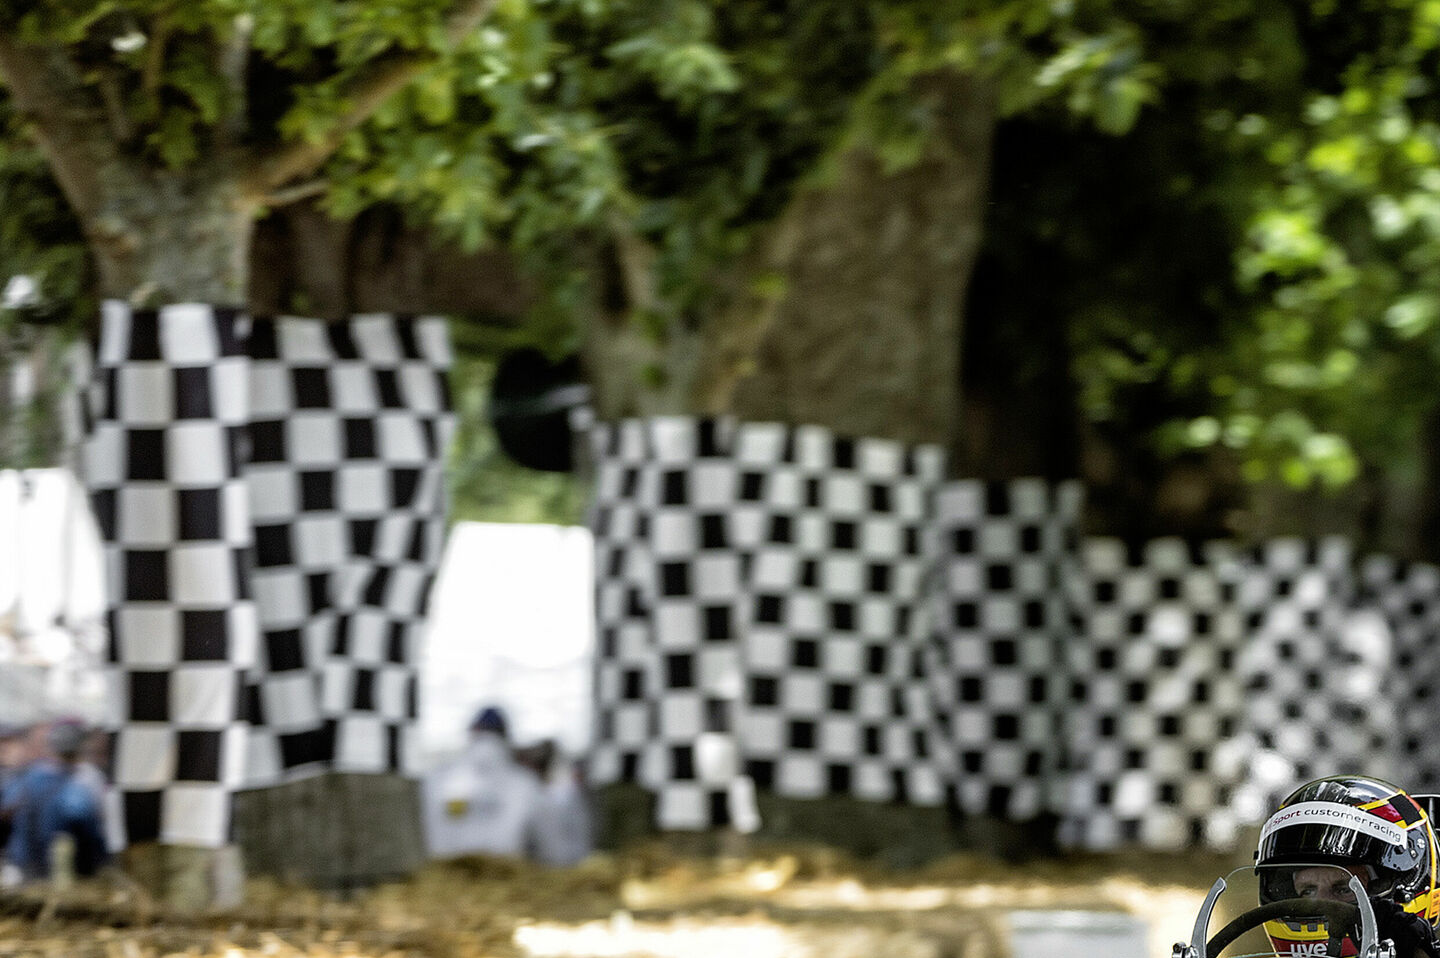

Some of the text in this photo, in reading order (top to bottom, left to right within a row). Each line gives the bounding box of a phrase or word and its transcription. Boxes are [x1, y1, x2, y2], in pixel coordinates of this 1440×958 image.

[1272, 808, 1402, 843] Sport customer racing
[1289, 942, 1329, 958] uve
